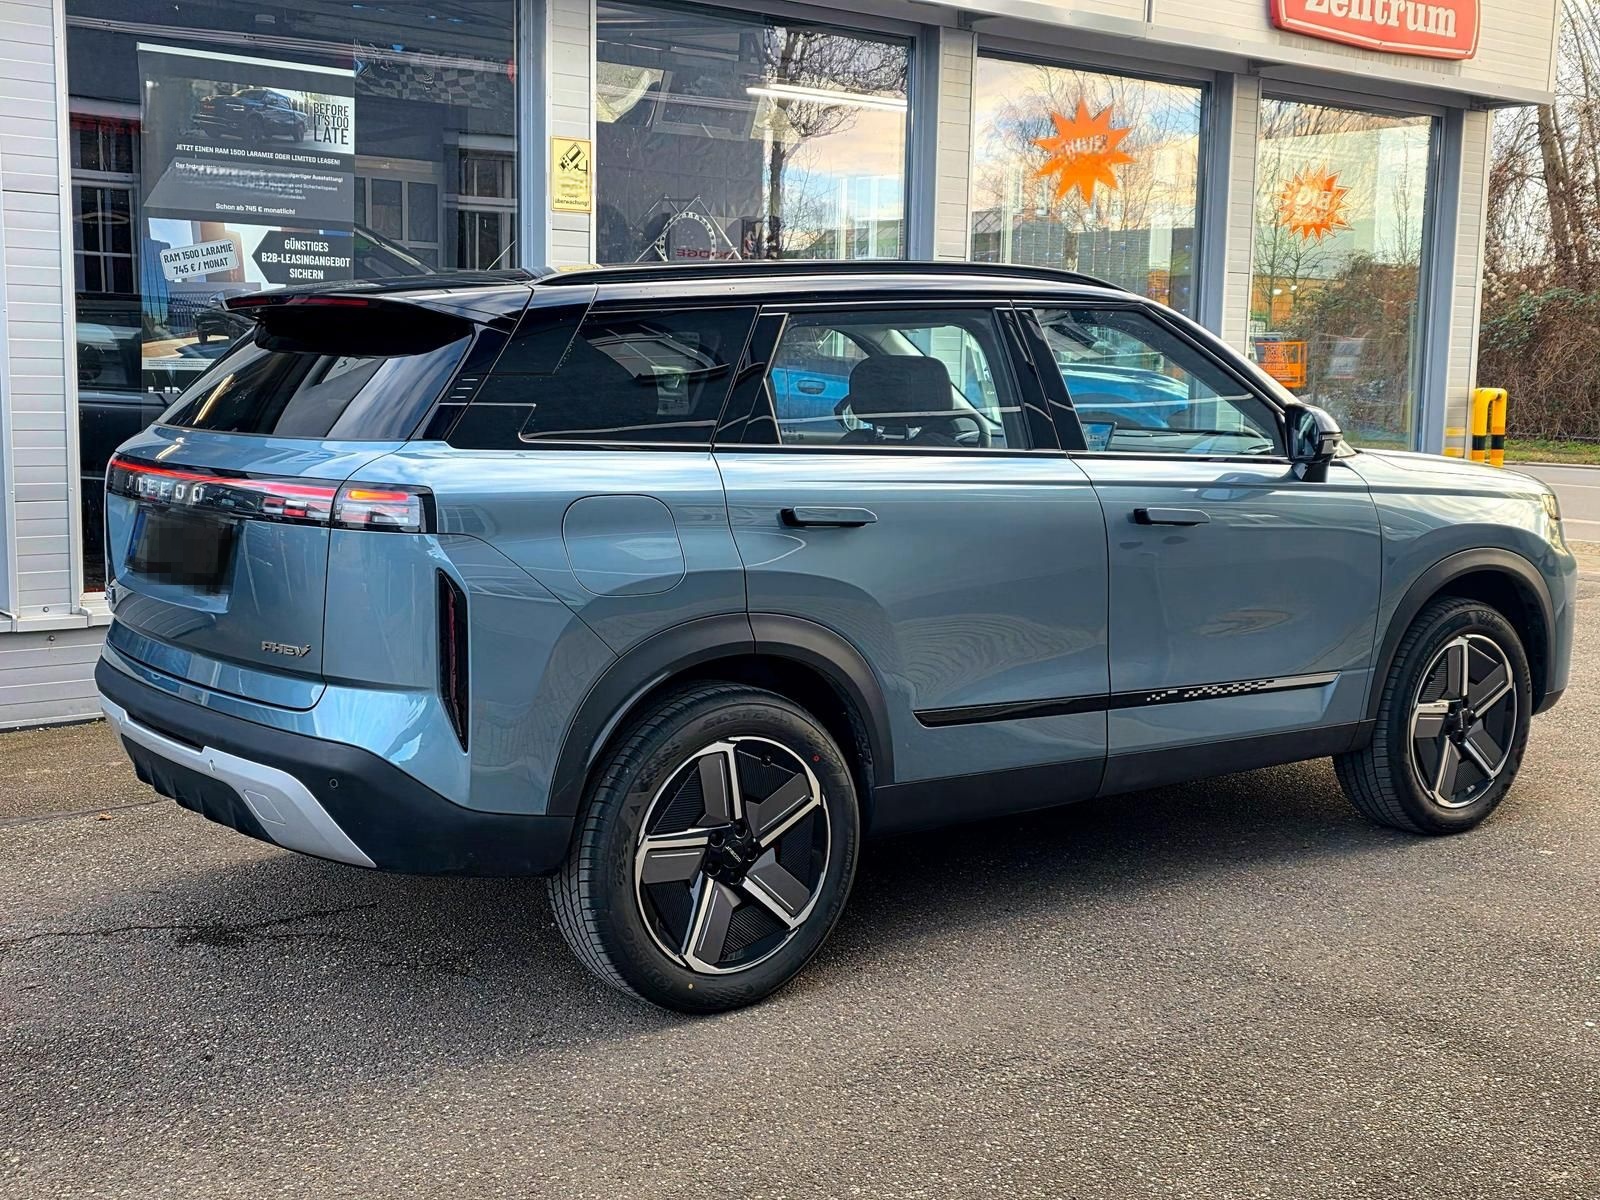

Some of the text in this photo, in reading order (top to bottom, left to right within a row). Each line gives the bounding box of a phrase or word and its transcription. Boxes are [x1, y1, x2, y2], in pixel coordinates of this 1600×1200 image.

[313, 102, 349, 117] BEFORE
[313, 113, 349, 129] IT'S TOO
[314, 126, 349, 145] LATE
[176, 143, 341, 166] JETZT EINEN RAM 1500 LARAMIE ODER LIMITED LEASEN!
[215, 202, 236, 211] Schon
[236, 204, 245, 212] ab
[245, 205, 257, 213] 745
[263, 207, 296, 215] monatlich!
[284, 237, 329, 252] GÜNSTIGES
[163, 243, 234, 264] RAM 1500 LARAMIE
[261, 252, 351, 268] B2B-LEASINGANGEBOT
[173, 257, 229, 275] 745 € / MONAT
[289, 268, 324, 280] SICHERN
[261, 641, 311, 658] PHEV
